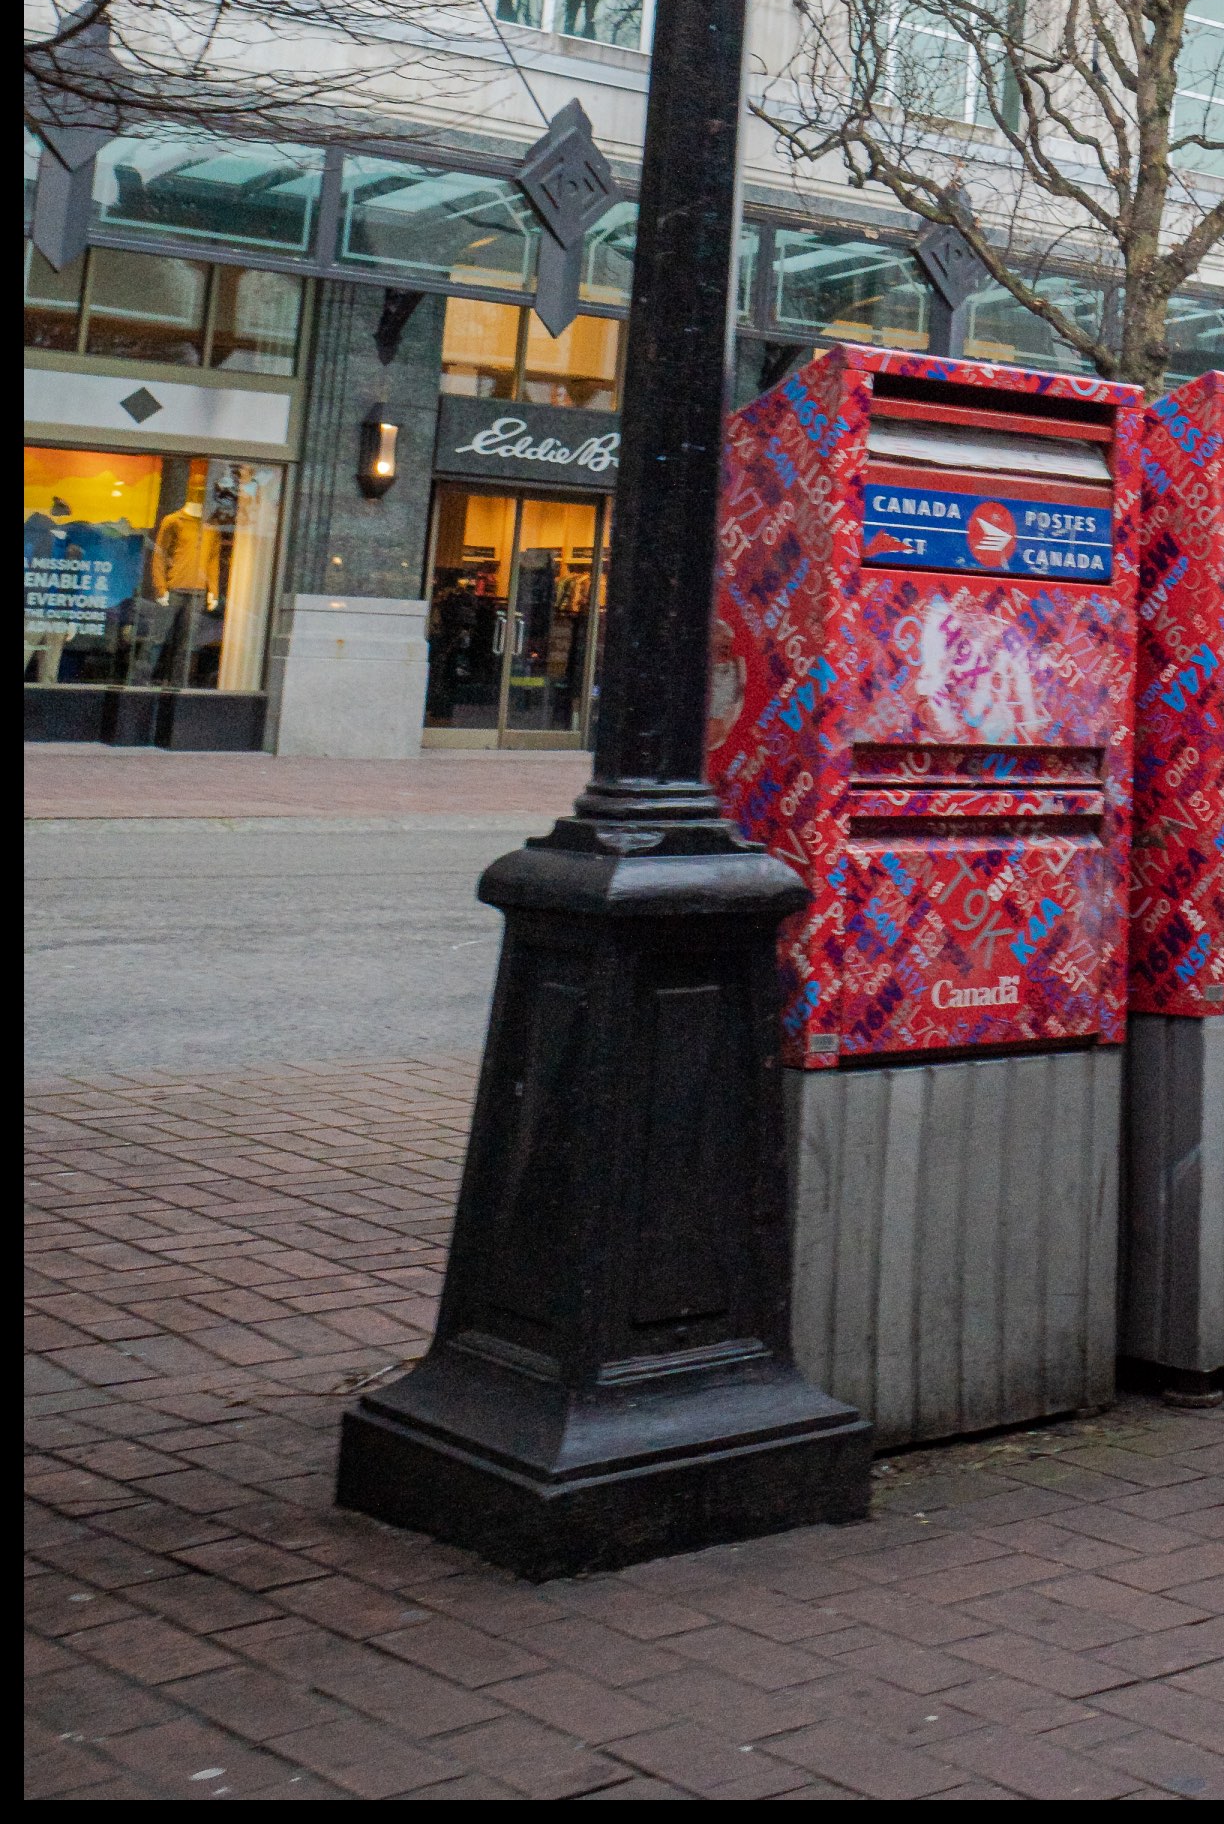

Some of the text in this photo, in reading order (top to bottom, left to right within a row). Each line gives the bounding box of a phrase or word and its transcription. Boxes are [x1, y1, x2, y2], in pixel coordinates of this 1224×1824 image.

[454, 417, 572, 464] Eddie
[872, 495, 962, 520] CANADA
[1024, 510, 1096, 533] POSTES
[93, 561, 113, 573] TO
[1022, 549, 1105, 571] CANADA
[24, 572, 92, 590] ENABLE
[26, 592, 107, 609] EVERYONE
[1160, 642, 1219, 713] K4A
[779, 655, 838, 732] K4A
[1009, 897, 1064, 966] K4A
[931, 975, 1020, 1009] Canada
